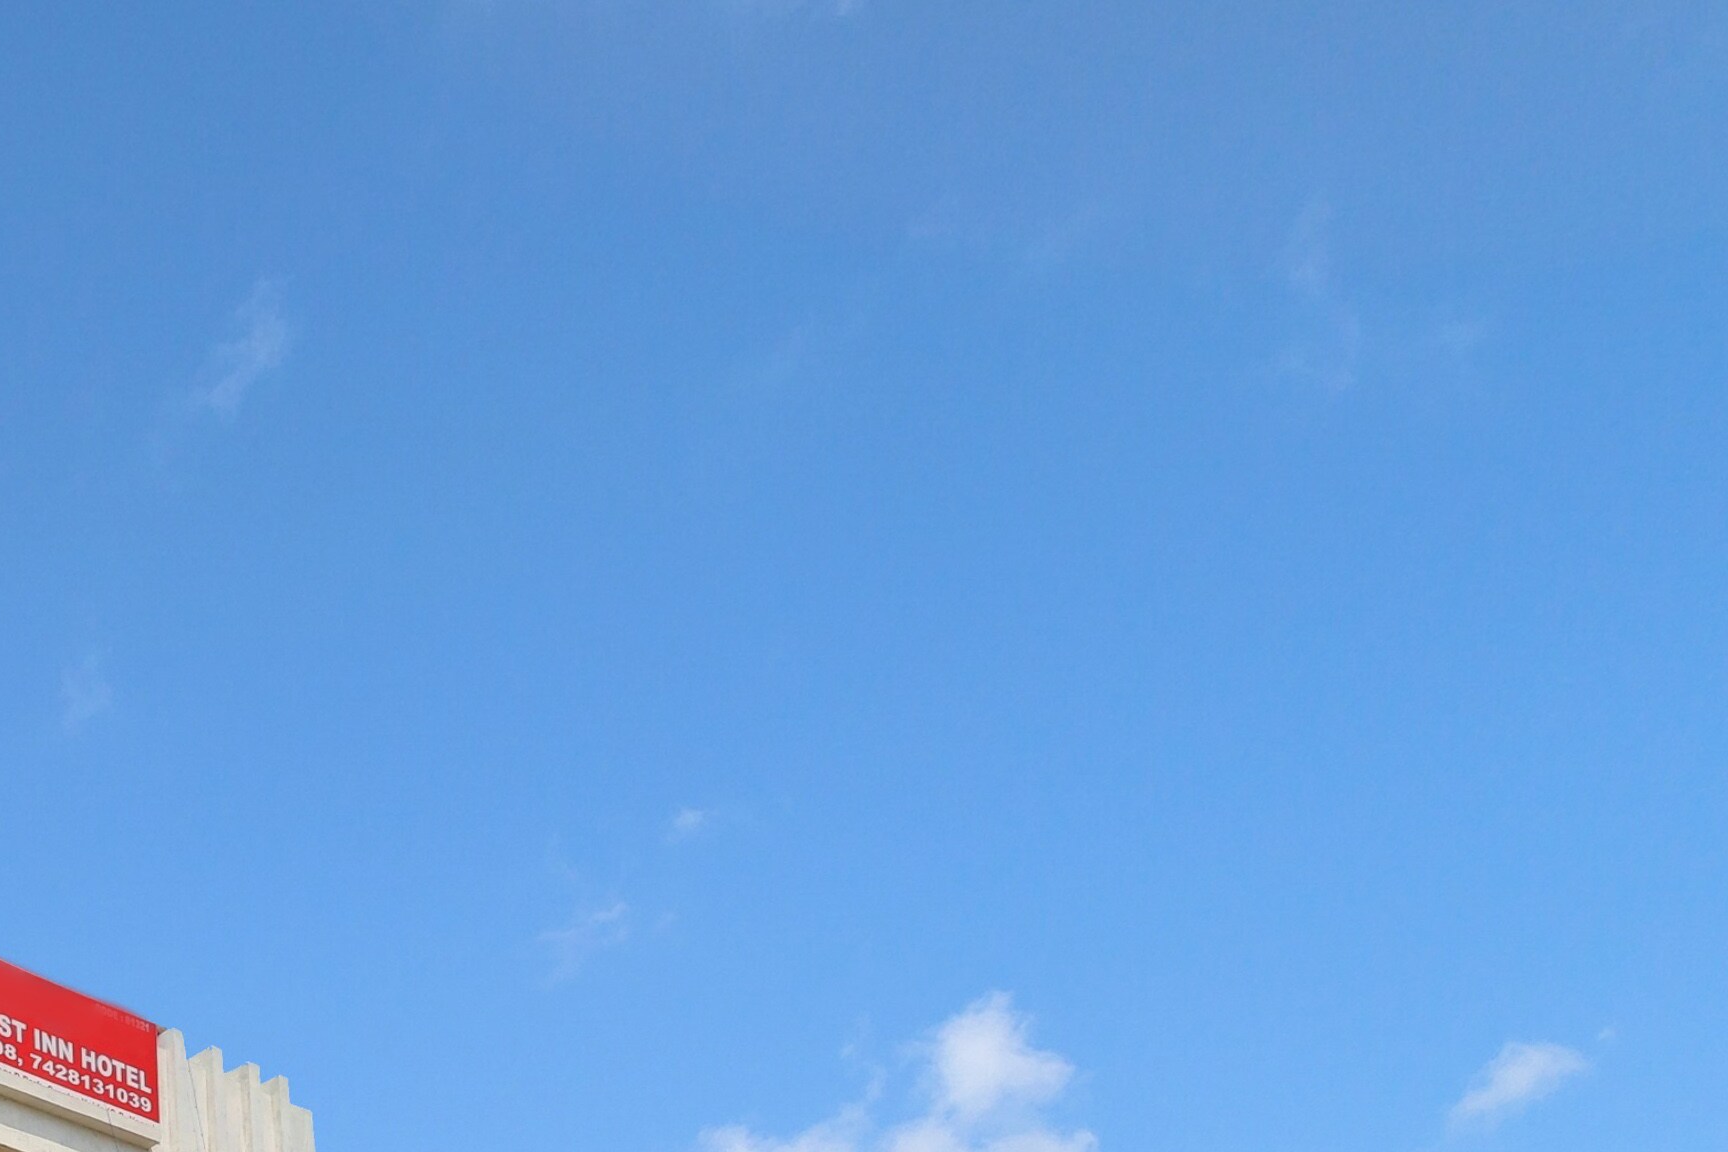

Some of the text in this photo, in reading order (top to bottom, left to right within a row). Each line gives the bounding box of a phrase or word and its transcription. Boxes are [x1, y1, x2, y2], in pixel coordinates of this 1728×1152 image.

[29, 1053, 152, 1113] 7428131039
[33, 1028, 74, 1064] INN
[81, 1047, 152, 1094] HOTEL
